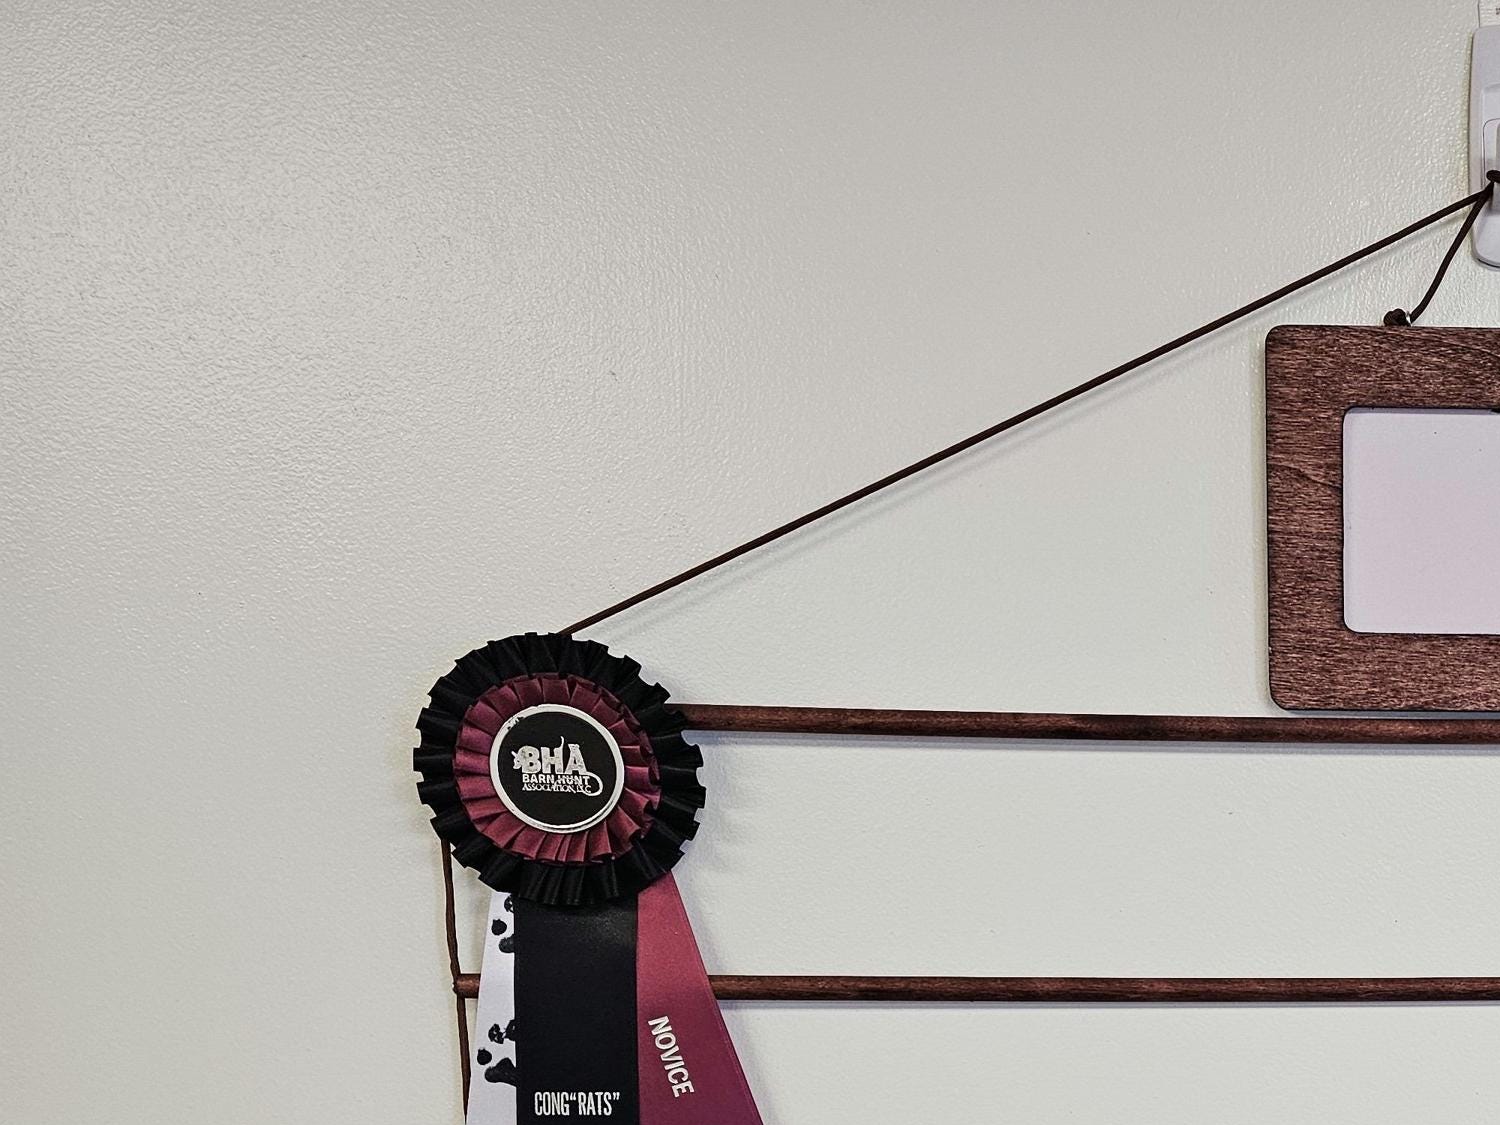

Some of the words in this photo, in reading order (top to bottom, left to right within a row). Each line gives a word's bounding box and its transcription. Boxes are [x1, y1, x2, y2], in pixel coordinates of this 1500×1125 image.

[513, 743, 587, 775] BHA
[522, 774, 555, 784] BARN
[647, 1015, 695, 1099] NOVICE
